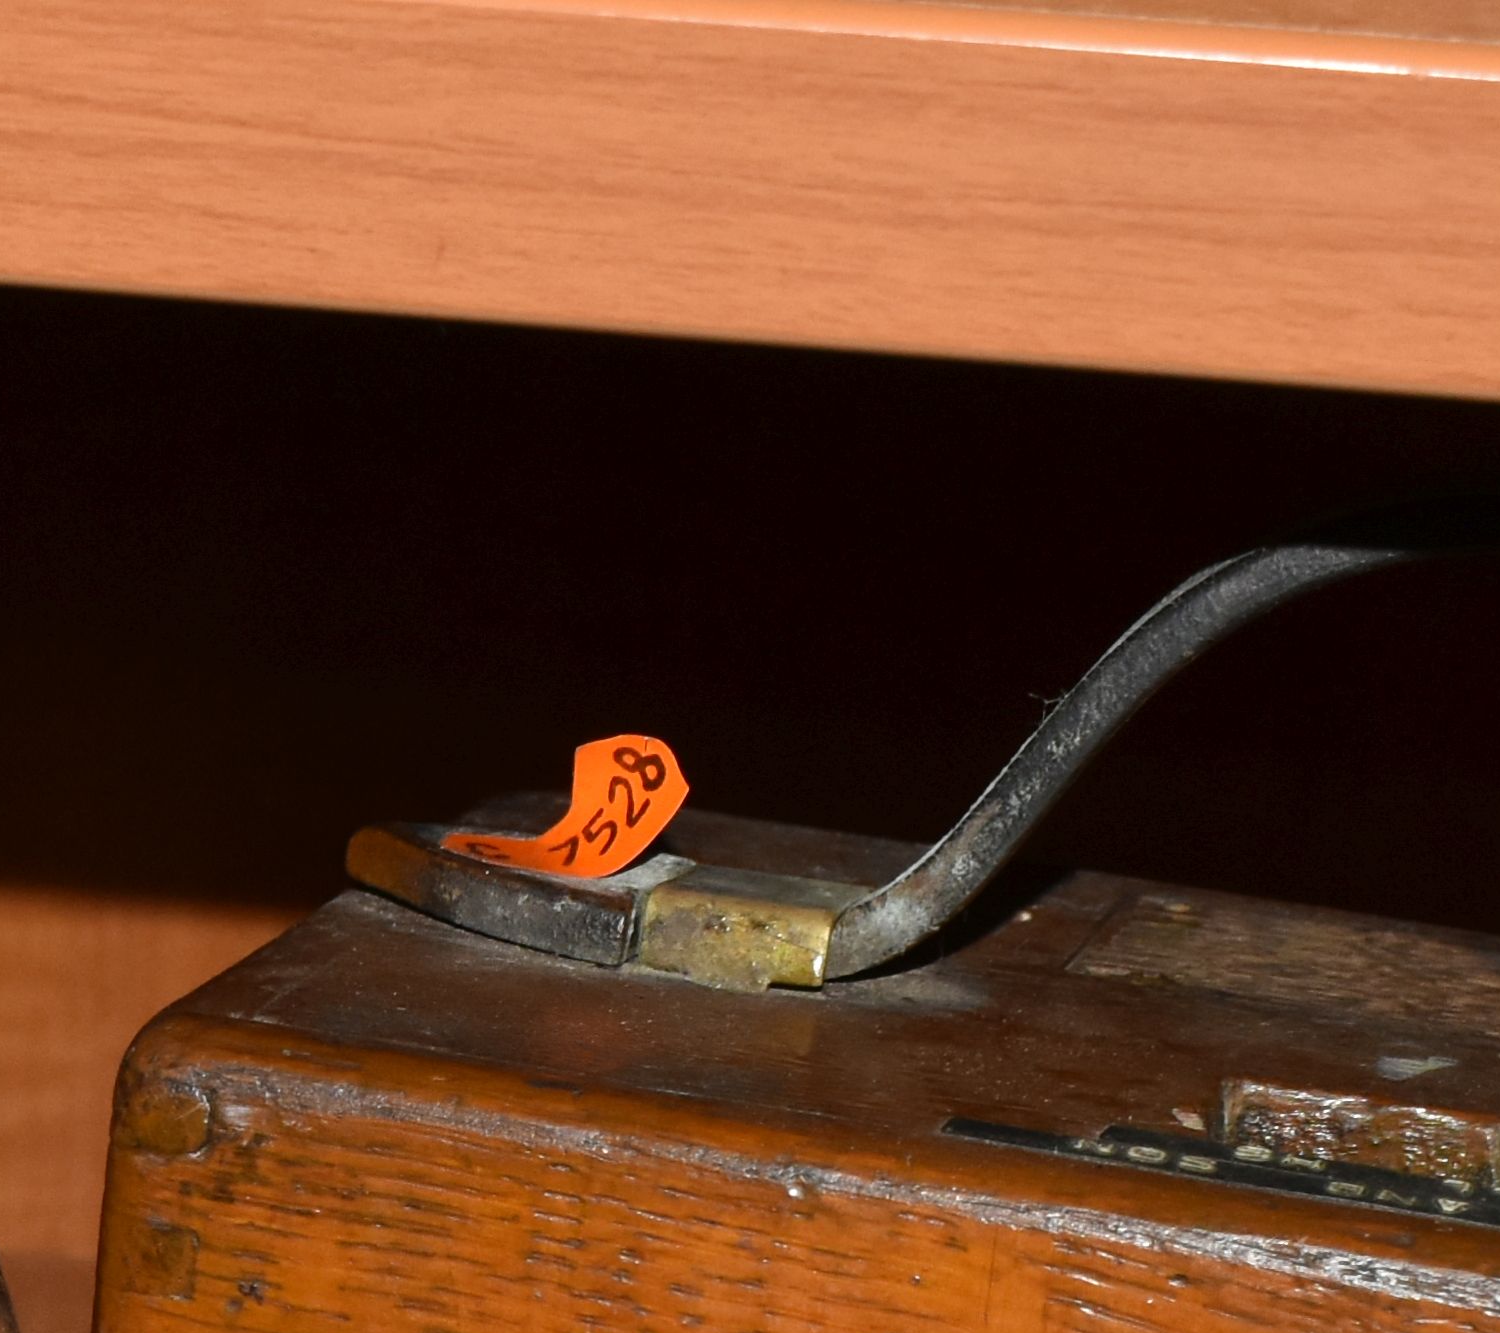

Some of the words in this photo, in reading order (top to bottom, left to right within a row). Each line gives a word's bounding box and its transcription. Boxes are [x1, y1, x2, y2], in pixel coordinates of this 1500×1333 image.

[548, 746, 667, 866] 7528
[1073, 1137, 1218, 1174] SON
[1327, 1180, 1469, 1214] AND
